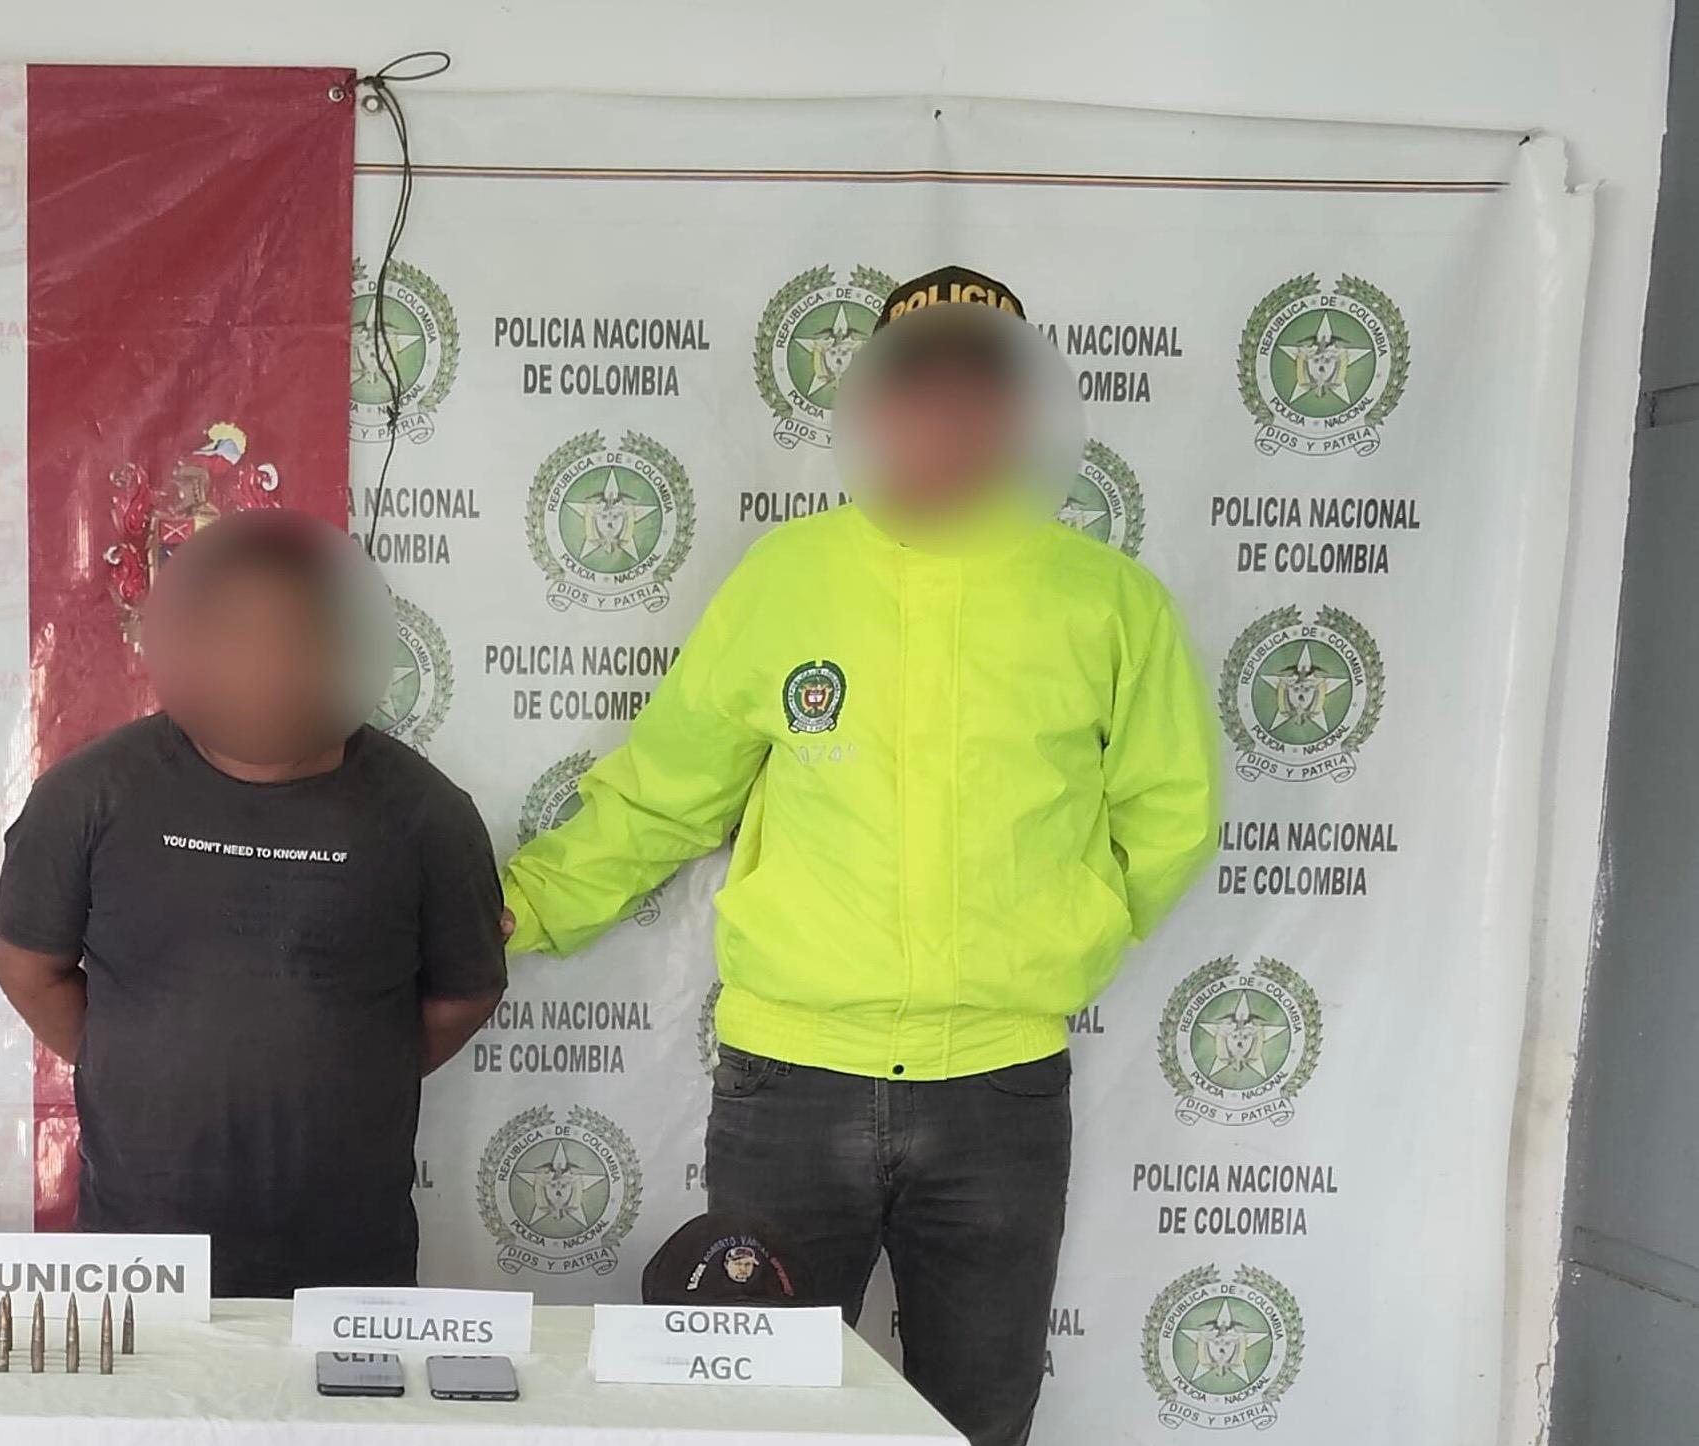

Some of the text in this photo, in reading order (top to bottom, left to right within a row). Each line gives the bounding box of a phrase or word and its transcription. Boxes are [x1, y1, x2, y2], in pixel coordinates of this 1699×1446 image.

[396, 287, 437, 344] COLOMBIA
[776, 293, 824, 349] REPUBLICA
[835, 288, 852, 299] DE
[1259, 296, 1388, 357] REPUBLICA DE COLOMBIA
[494, 317, 710, 350] POLICIA NACIONAL
[1067, 324, 1183, 357] NACIONAL
[523, 364, 679, 396] DE COLOMBIA
[1078, 371, 1151, 402] OMBIA
[787, 390, 824, 419] POLICIA
[1269, 395, 1375, 428] POLICIA NACIONAL
[784, 420, 817, 441] DIOS
[1266, 427, 1372, 451] DIOS Y PATRIA
[548, 453, 674, 514] REPUBLICA DE COLOMBIA
[1084, 465, 1123, 519] COLOMBIA
[364, 487, 480, 518] NACIONAL
[740, 492, 829, 522] POLICIA
[1211, 497, 1420, 529] POLICIA NACIONAL
[560, 552, 662, 584] POLICIA NACIONAL
[1237, 542, 1389, 574] DE COLOMBIA
[557, 583, 661, 608] DIOS Y PATRIA
[397, 625, 432, 676] OLOMBIA
[485, 645, 681, 676] POLICIA NACIONA
[1240, 627, 1365, 687] REPUBLICA DE COLOMBIA
[513, 690, 650, 720] DE COLOMB
[1251, 724, 1351, 755] POLICIA NACIONAL
[1247, 754, 1348, 778] DIOS Y PATRIA
[540, 777, 582, 830] REPUBLIC
[162, 835, 348, 863] YOU DON'T NEED TO KNOW ALL OF
[1218, 822, 1398, 852] LICIA NACIONAL
[1218, 865, 1367, 896] DE COLOMBIA
[541, 1001, 653, 1030] NACIONAL
[1180, 977, 1302, 1034] REPUBLICA DE COLOMBIA
[474, 1044, 625, 1073] DE COLOMBIA
[1190, 1071, 1289, 1100] POLICIA NACIONAL
[1186, 1099, 1287, 1122] DIOS Y PATRIA
[498, 1126, 621, 1184] REPUBLICA DE COLOMBIA
[1133, 1163, 1338, 1193] POLICIA NACIONAL
[510, 1219, 610, 1249] POLICIA NACIONAL
[1158, 1206, 1307, 1235] DE COLOMBIA
[507, 1247, 609, 1270] DIOS Y PATRIA
[664, 1309, 774, 1336] GORRA
[1163, 1284, 1284, 1341] REPUBLICA DE COLOMBIA
[332, 1314, 494, 1344] CELULARES
[688, 1355, 752, 1381] AGC
[1172, 1375, 1271, 1404] POLICIA NACIONAL
[1169, 1402, 1269, 1426] DIOS Y PATRIA
